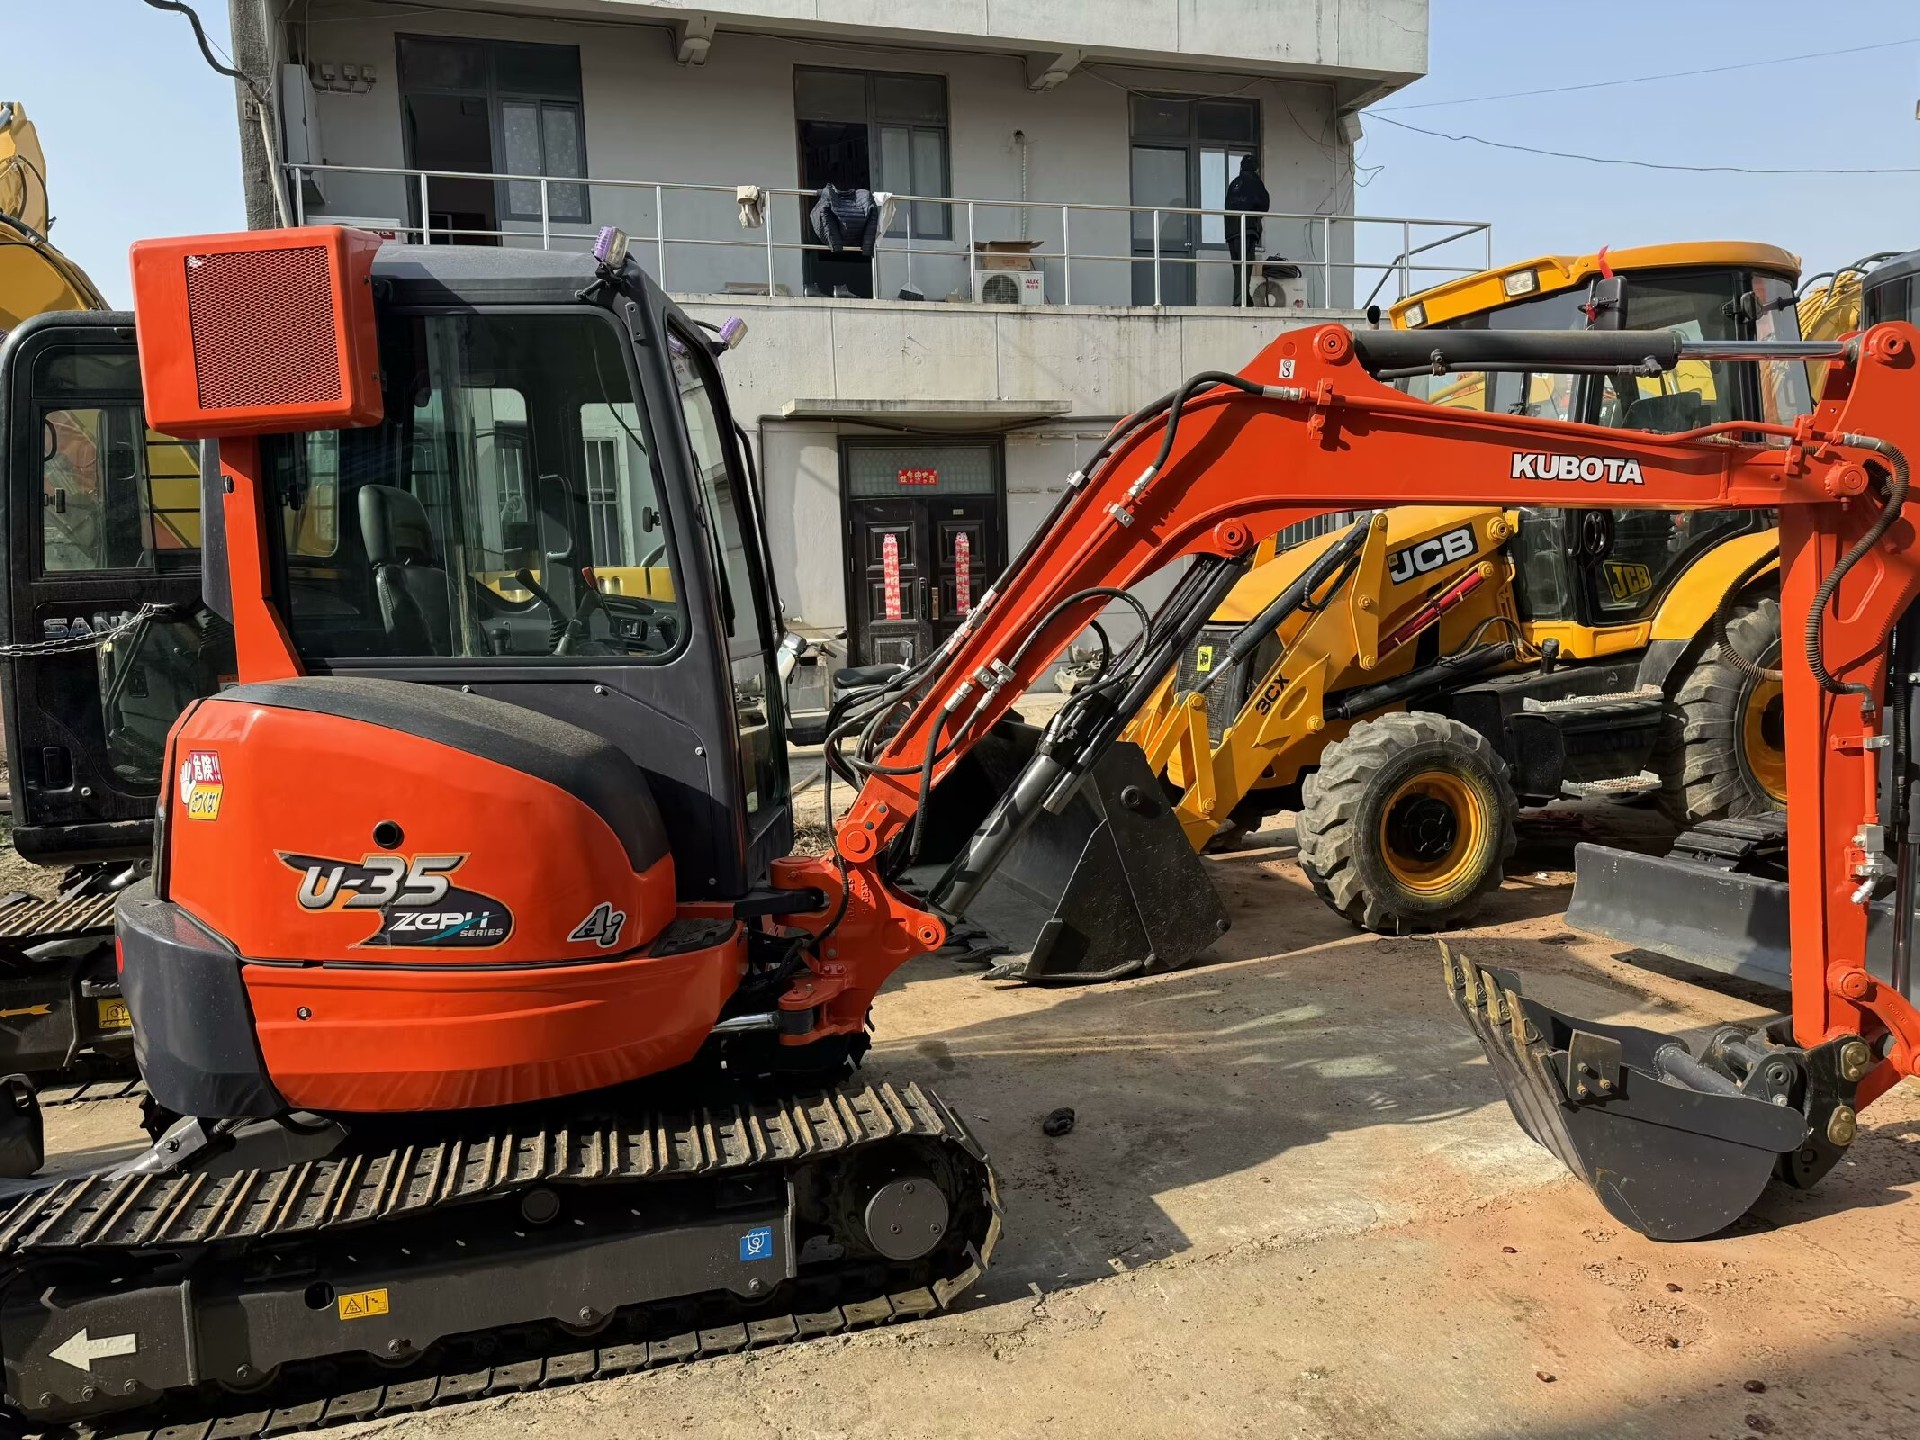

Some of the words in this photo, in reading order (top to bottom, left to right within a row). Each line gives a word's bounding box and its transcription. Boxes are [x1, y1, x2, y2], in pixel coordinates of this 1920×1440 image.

[1511, 452, 1644, 485] KUBOTA
[1390, 529, 1474, 582] JCB
[1612, 565, 1650, 599] JCB
[1255, 674, 1290, 716] 3CX
[297, 854, 464, 910] U-35
[459, 927, 504, 938] SERIES
